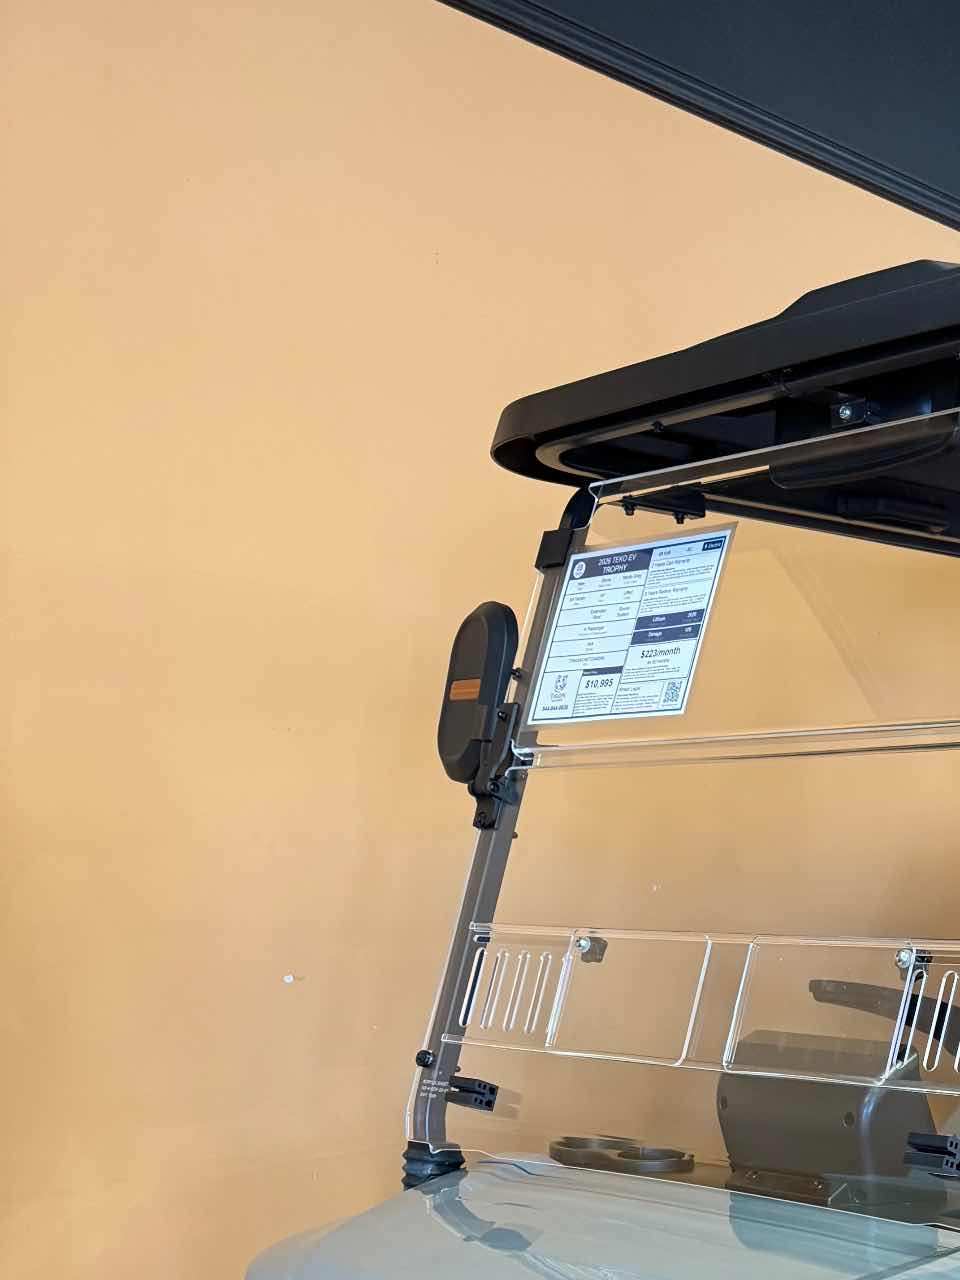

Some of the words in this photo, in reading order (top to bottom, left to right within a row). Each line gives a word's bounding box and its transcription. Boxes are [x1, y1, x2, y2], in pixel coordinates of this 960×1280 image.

[598, 558, 611, 566] 2026
[612, 555, 628, 564] TEKO
[628, 553, 637, 561] EV
[602, 564, 627, 574] TROPHY
[640, 647, 681, 659] $223/month
[585, 678, 614, 689] $10,995
